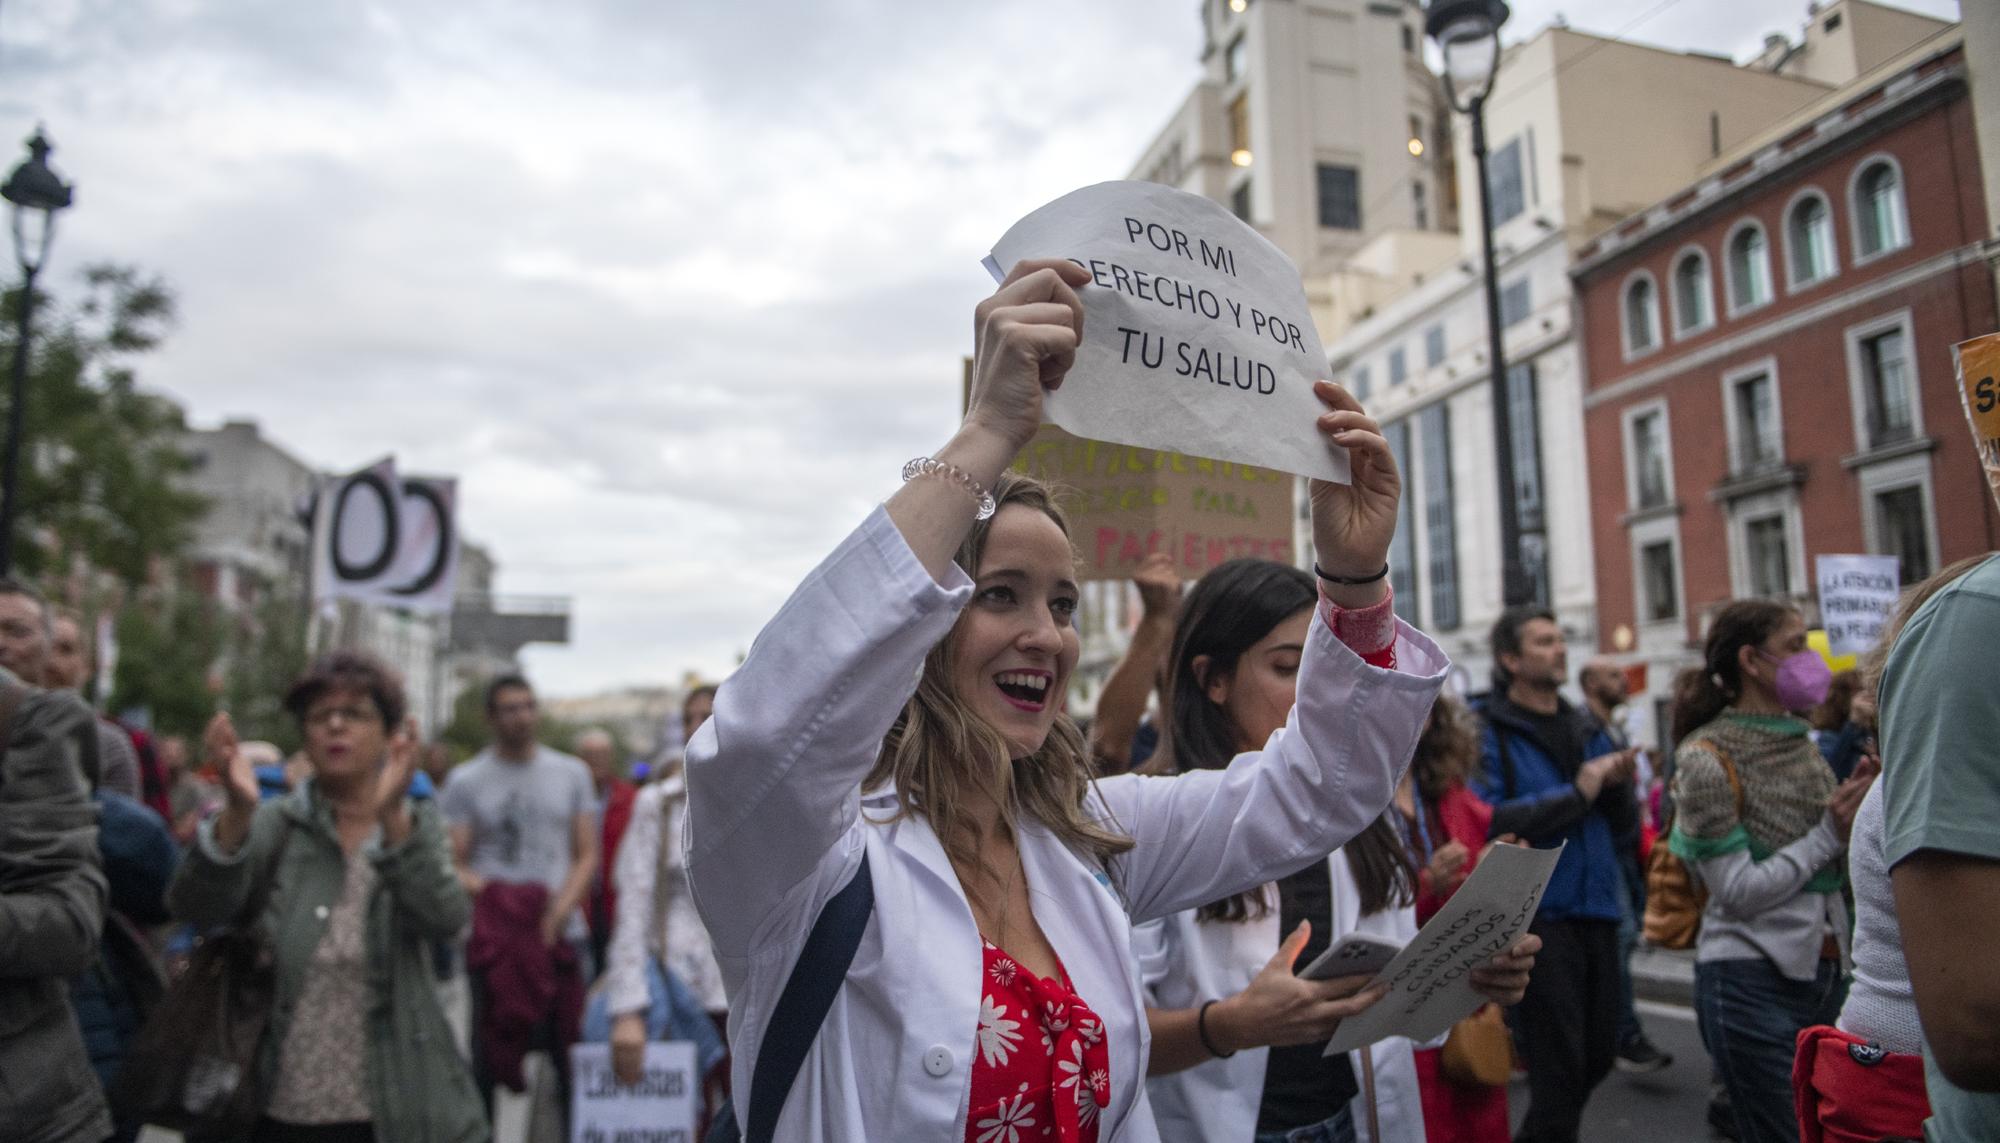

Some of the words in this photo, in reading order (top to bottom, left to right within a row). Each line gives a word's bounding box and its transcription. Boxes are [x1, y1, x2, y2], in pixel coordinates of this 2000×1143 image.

[1124, 216, 1193, 260] POR
[1200, 239, 1238, 277] MI
[1226, 297, 1241, 329] Y
[1251, 308, 1306, 353] POR
[1117, 327, 1164, 369] TU
[1175, 342, 1276, 395] SALUD
[1975, 376, 2000, 413] S
[1407, 911, 1506, 993] CUIDADOS
[1424, 907, 1482, 954] UNOS
